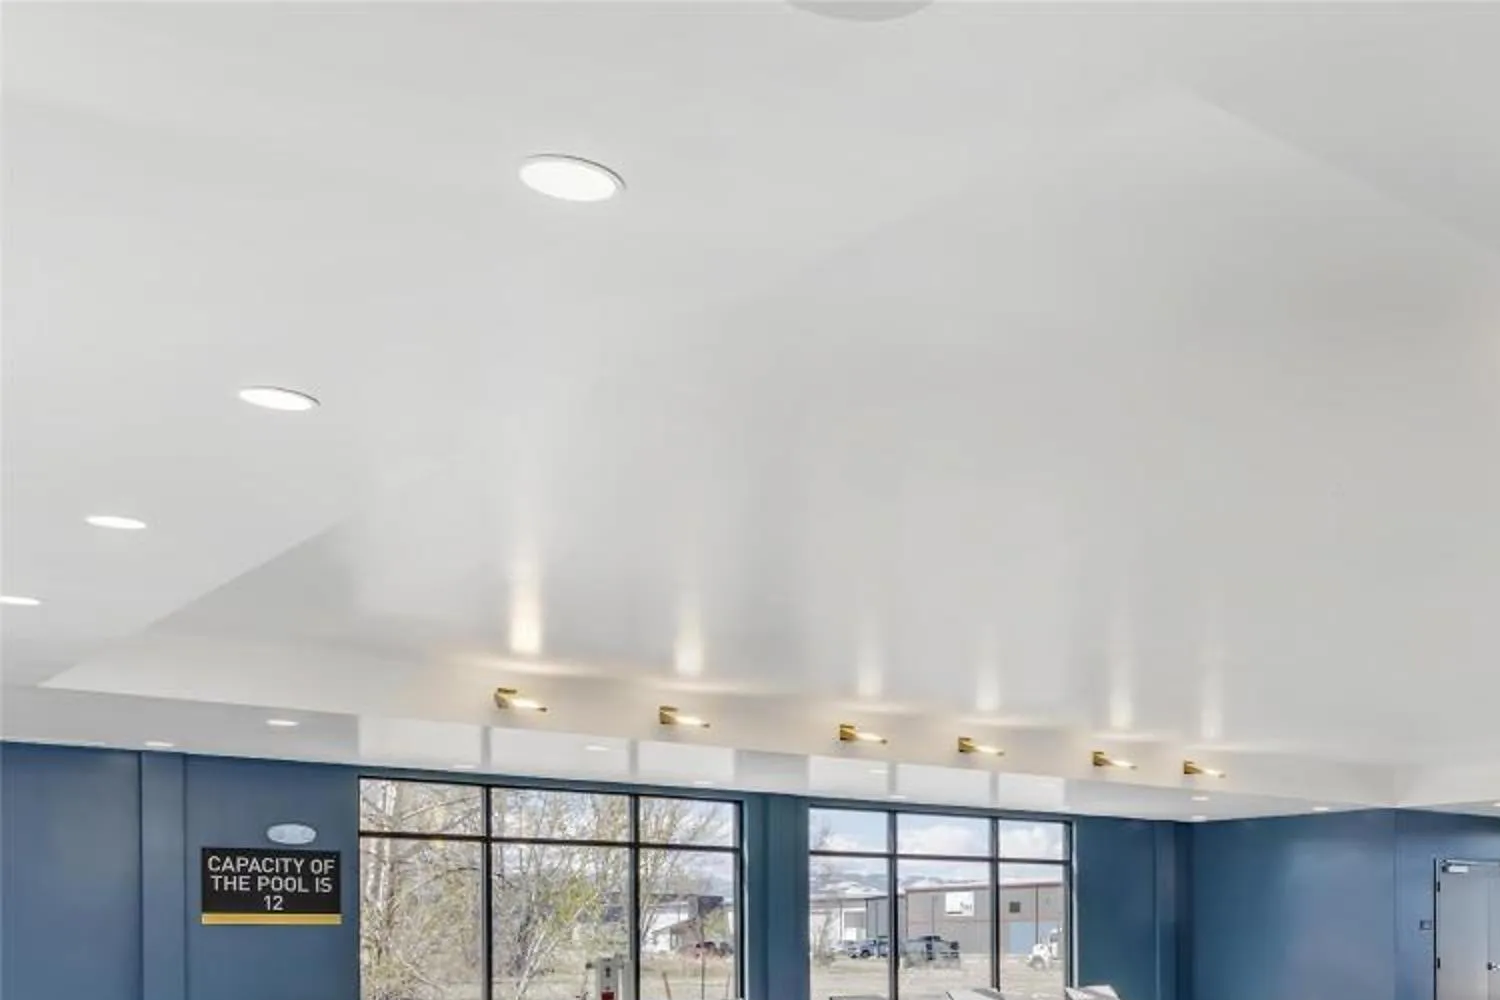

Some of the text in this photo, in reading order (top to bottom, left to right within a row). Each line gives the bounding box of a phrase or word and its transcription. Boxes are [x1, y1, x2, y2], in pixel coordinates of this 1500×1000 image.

[207, 855, 336, 875] CAPACITY OF
[210, 875, 333, 894] THE POOL IS
[263, 895, 284, 911] 12
